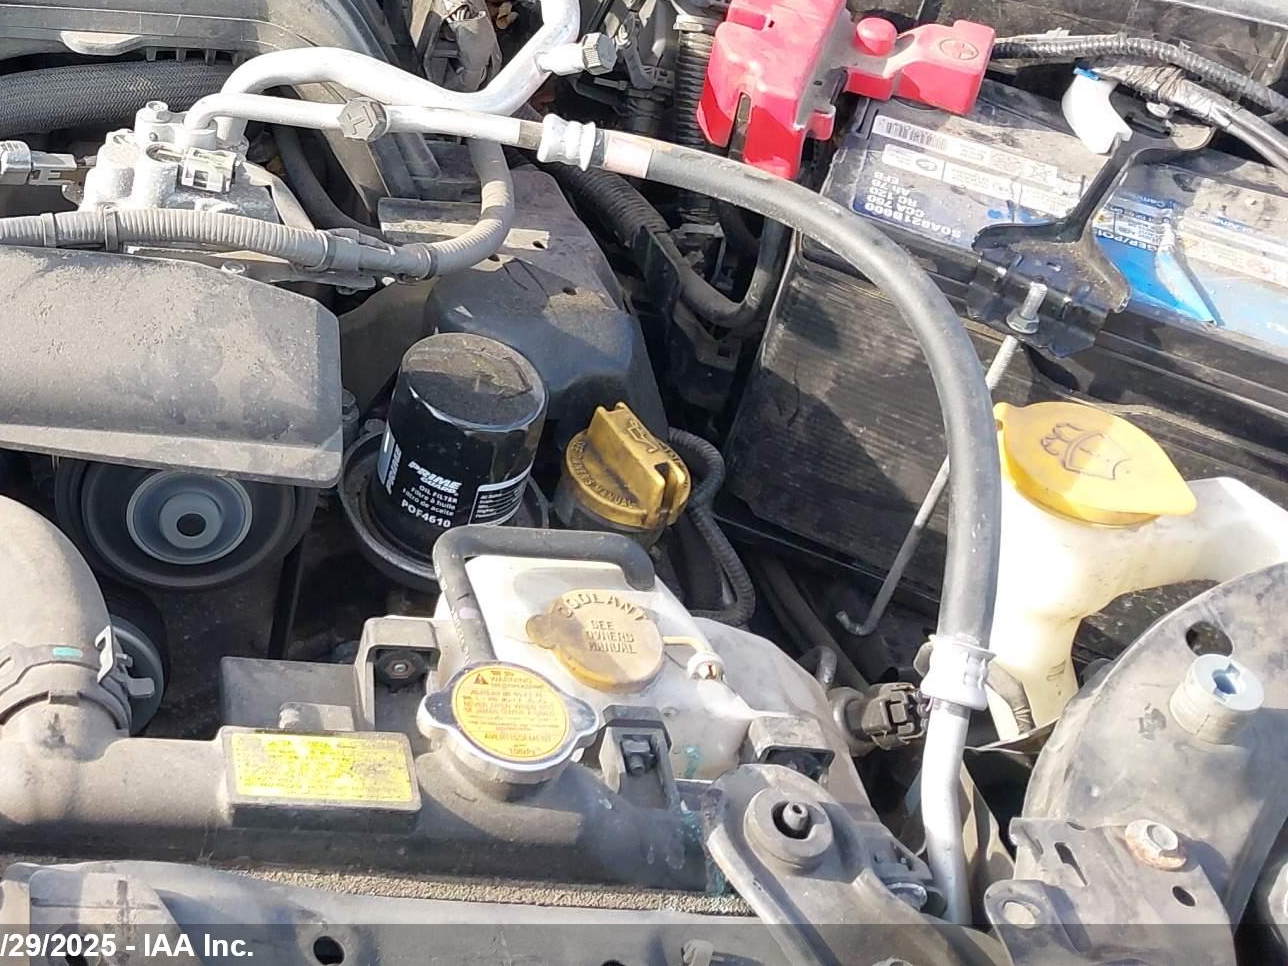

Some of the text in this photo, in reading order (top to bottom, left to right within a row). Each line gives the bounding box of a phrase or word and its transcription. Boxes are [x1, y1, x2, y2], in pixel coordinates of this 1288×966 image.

[869, 187, 893, 200] 120
[897, 205, 925, 218] CCA
[407, 461, 462, 490] PRIME
[418, 485, 458, 504] OIL FILTER
[436, 500, 456, 510] huile
[401, 499, 452, 528] POF4610
[558, 593, 648, 621] COOLANT
[590, 620, 614, 630] SEE
[588, 641, 637, 654] MANUAL
